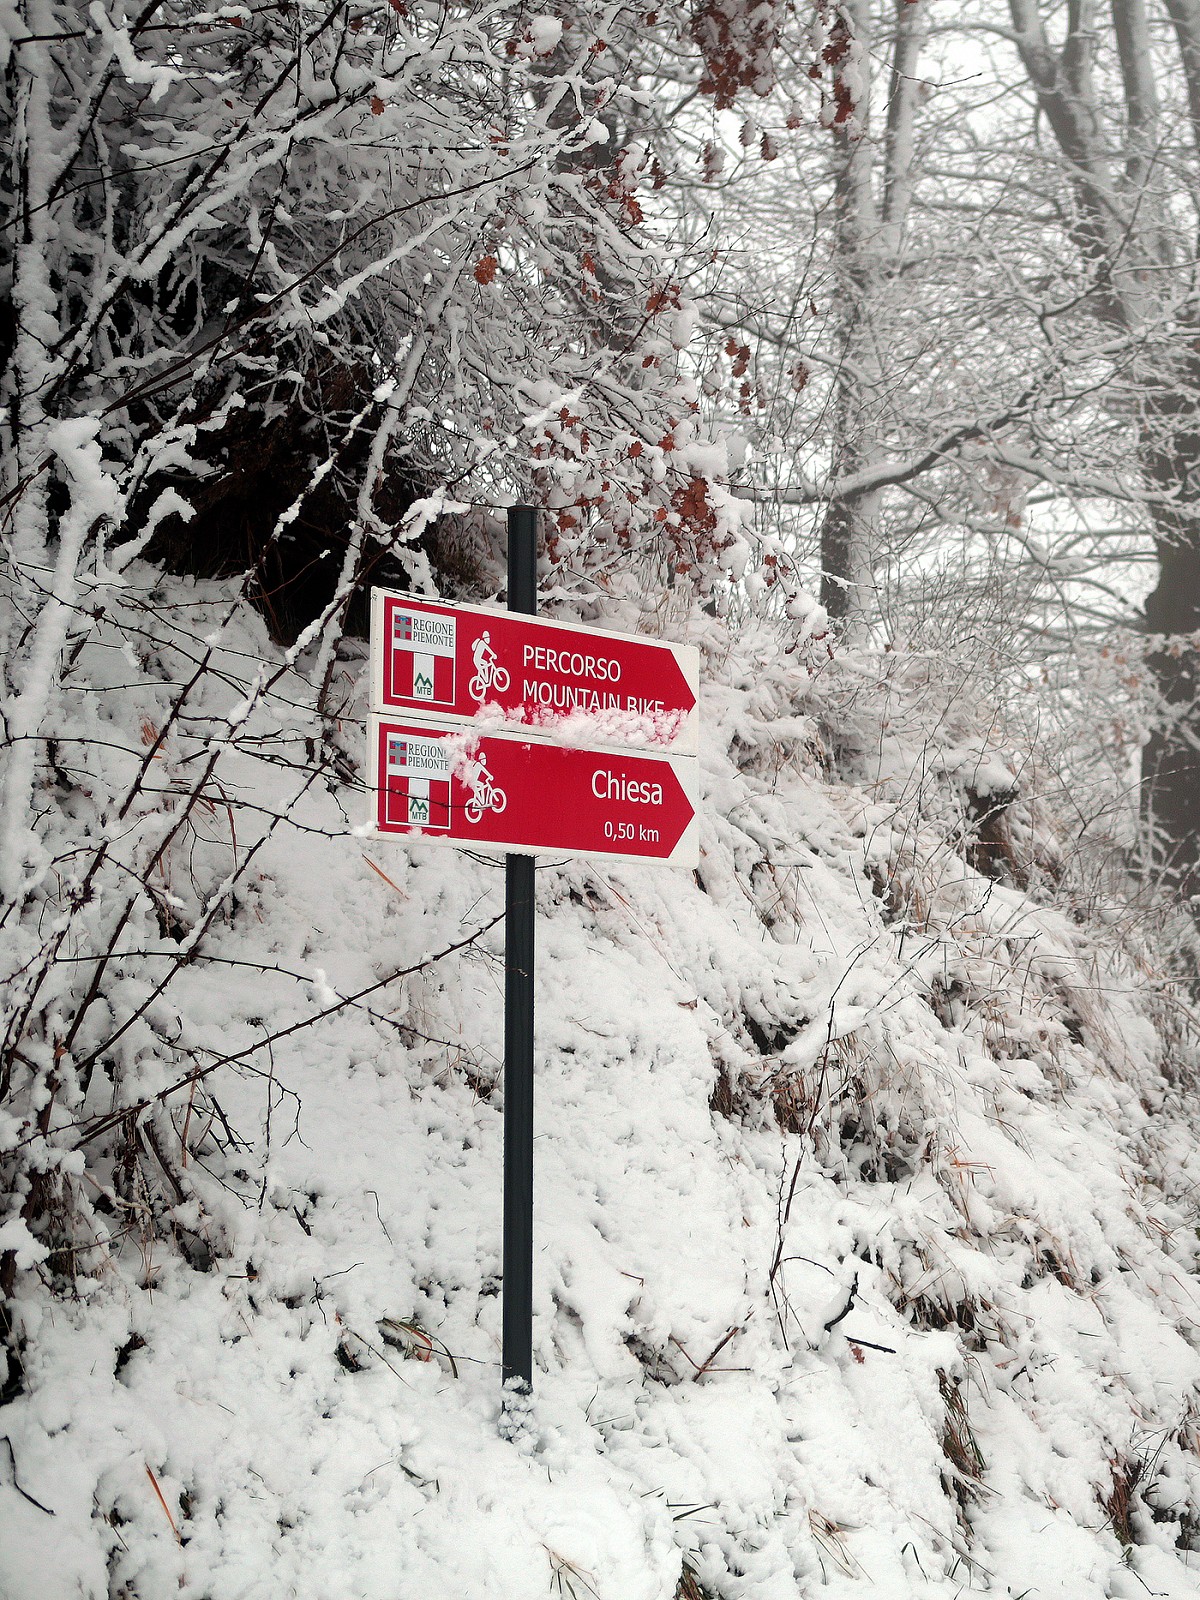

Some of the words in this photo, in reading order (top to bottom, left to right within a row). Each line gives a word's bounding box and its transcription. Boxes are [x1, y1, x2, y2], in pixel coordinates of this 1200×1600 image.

[413, 618, 454, 637] REGIONE
[413, 631, 454, 648] PIEMONTE
[523, 644, 622, 683] PERCORSO
[416, 686, 432, 696] MTB
[523, 679, 621, 712] MOUNTAIN
[408, 756, 449, 771] PIEMONTE
[591, 769, 663, 805] Chiesa
[411, 811, 427, 821] MTB
[604, 821, 635, 842] 0,50
[639, 824, 660, 843] km
